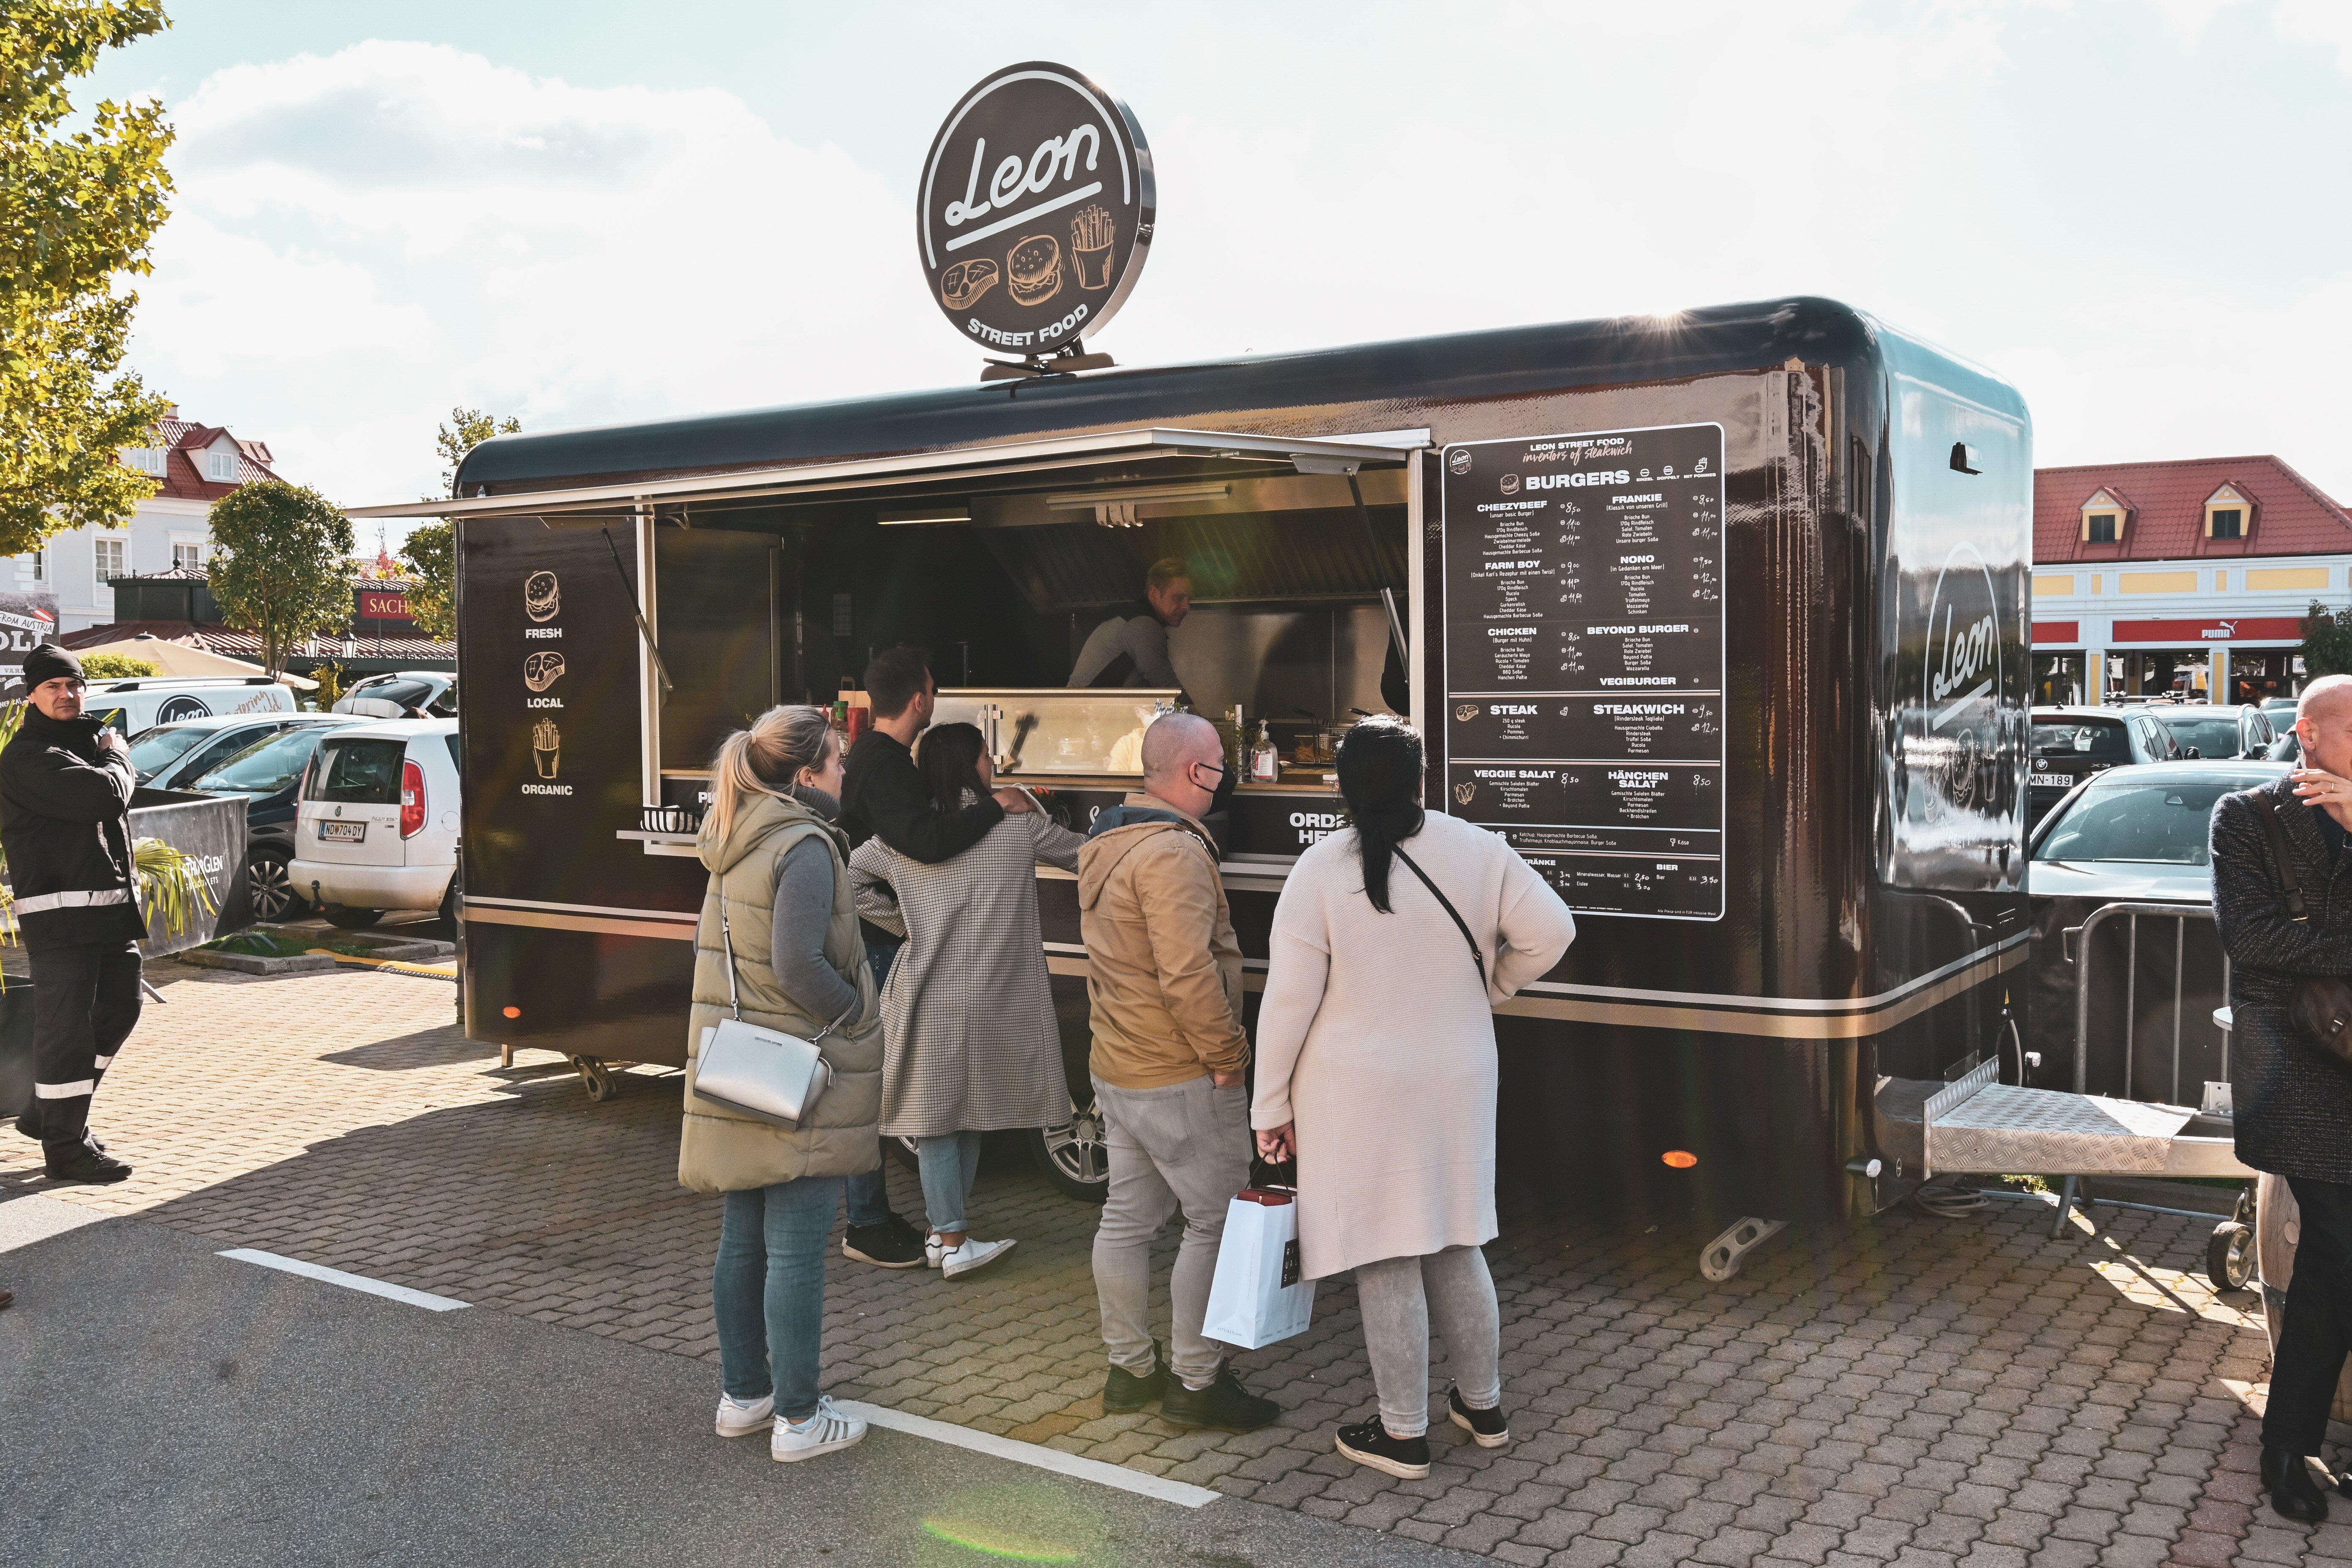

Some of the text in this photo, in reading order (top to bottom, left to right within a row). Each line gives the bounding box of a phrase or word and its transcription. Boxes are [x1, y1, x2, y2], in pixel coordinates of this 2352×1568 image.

[945, 124, 1100, 226] Leon
[968, 304, 1088, 346] STREET FOOD
[1558, 440, 1594, 449] STREET
[1597, 438, 1625, 446] FOOD
[1523, 440, 1632, 466] inventors of steakwich
[1452, 454, 1469, 463] Leon
[1526, 470, 1630, 490] BURGERS
[1612, 494, 1662, 504] FRANKIE
[1477, 500, 1547, 512] CHEEZYBEEF
[1620, 555, 1655, 564] NONO
[22, 621, 53, 633] AUSTRIA
[1488, 627, 1537, 636] CHICKEN
[1587, 624, 1688, 634] BEYOND BURGER
[525, 628, 562, 639] FRESH
[2202, 629, 2230, 638] PUMA
[1933, 603, 1994, 702] Leon
[1600, 677, 1676, 686] VEGIBURGER
[527, 697, 564, 708] LOCAL
[1490, 705, 1538, 715] STEAK
[1593, 704, 1684, 714] STEAKWICH
[1519, 770, 1555, 779] SALAT
[1608, 770, 1668, 780] HÄNCHEN
[522, 784, 573, 796] ORGANIC
